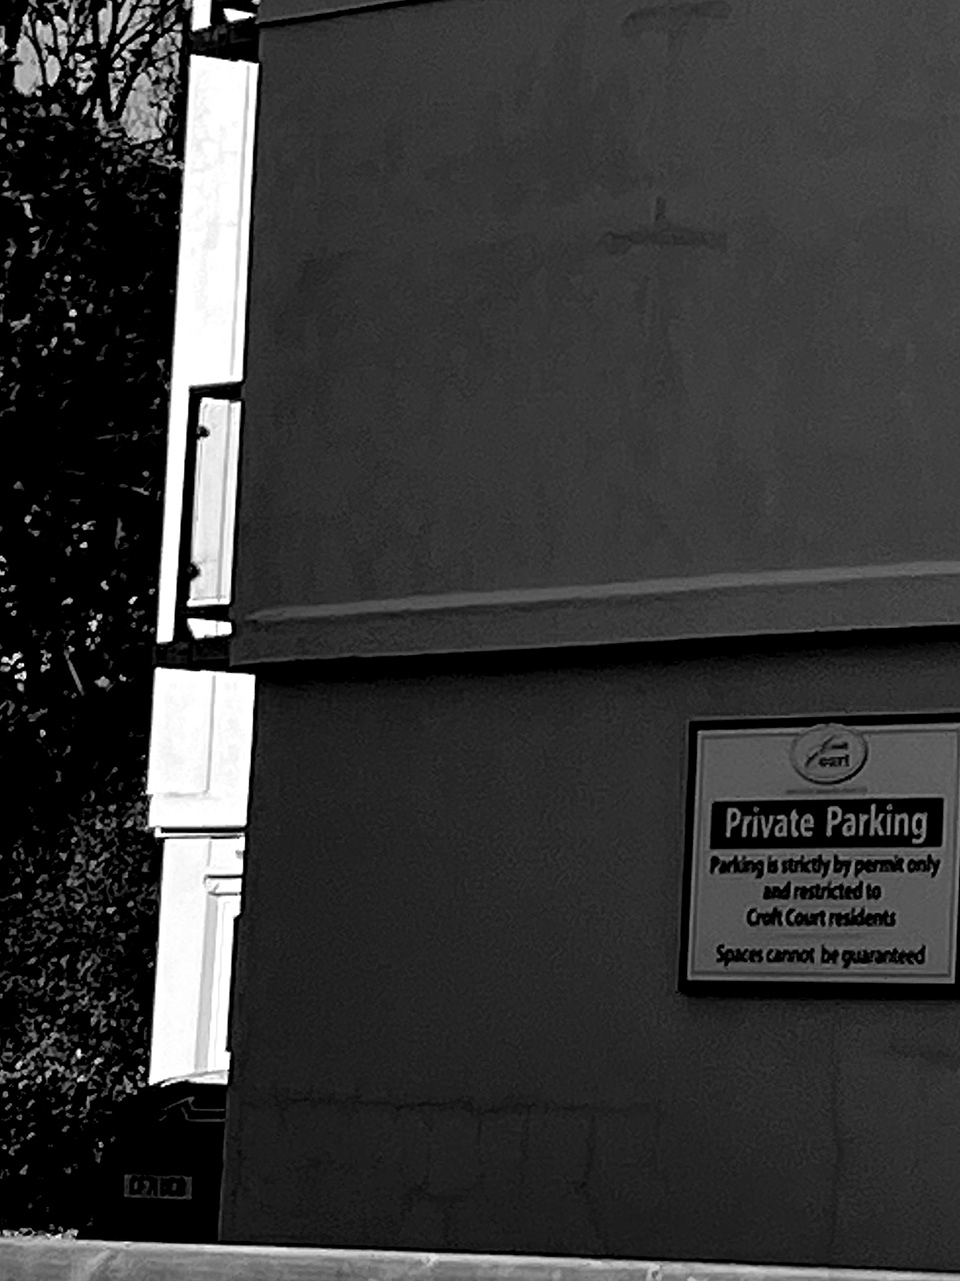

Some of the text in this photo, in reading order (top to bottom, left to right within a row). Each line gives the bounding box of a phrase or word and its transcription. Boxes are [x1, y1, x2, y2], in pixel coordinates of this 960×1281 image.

[725, 803, 928, 844] Private Parking
[710, 854, 940, 878] Parking is strictly by permit only
[763, 881, 882, 900] and restricted to
[746, 906, 897, 927] Croft Court residents
[716, 943, 927, 968] Spaces cannot be guaranteed
